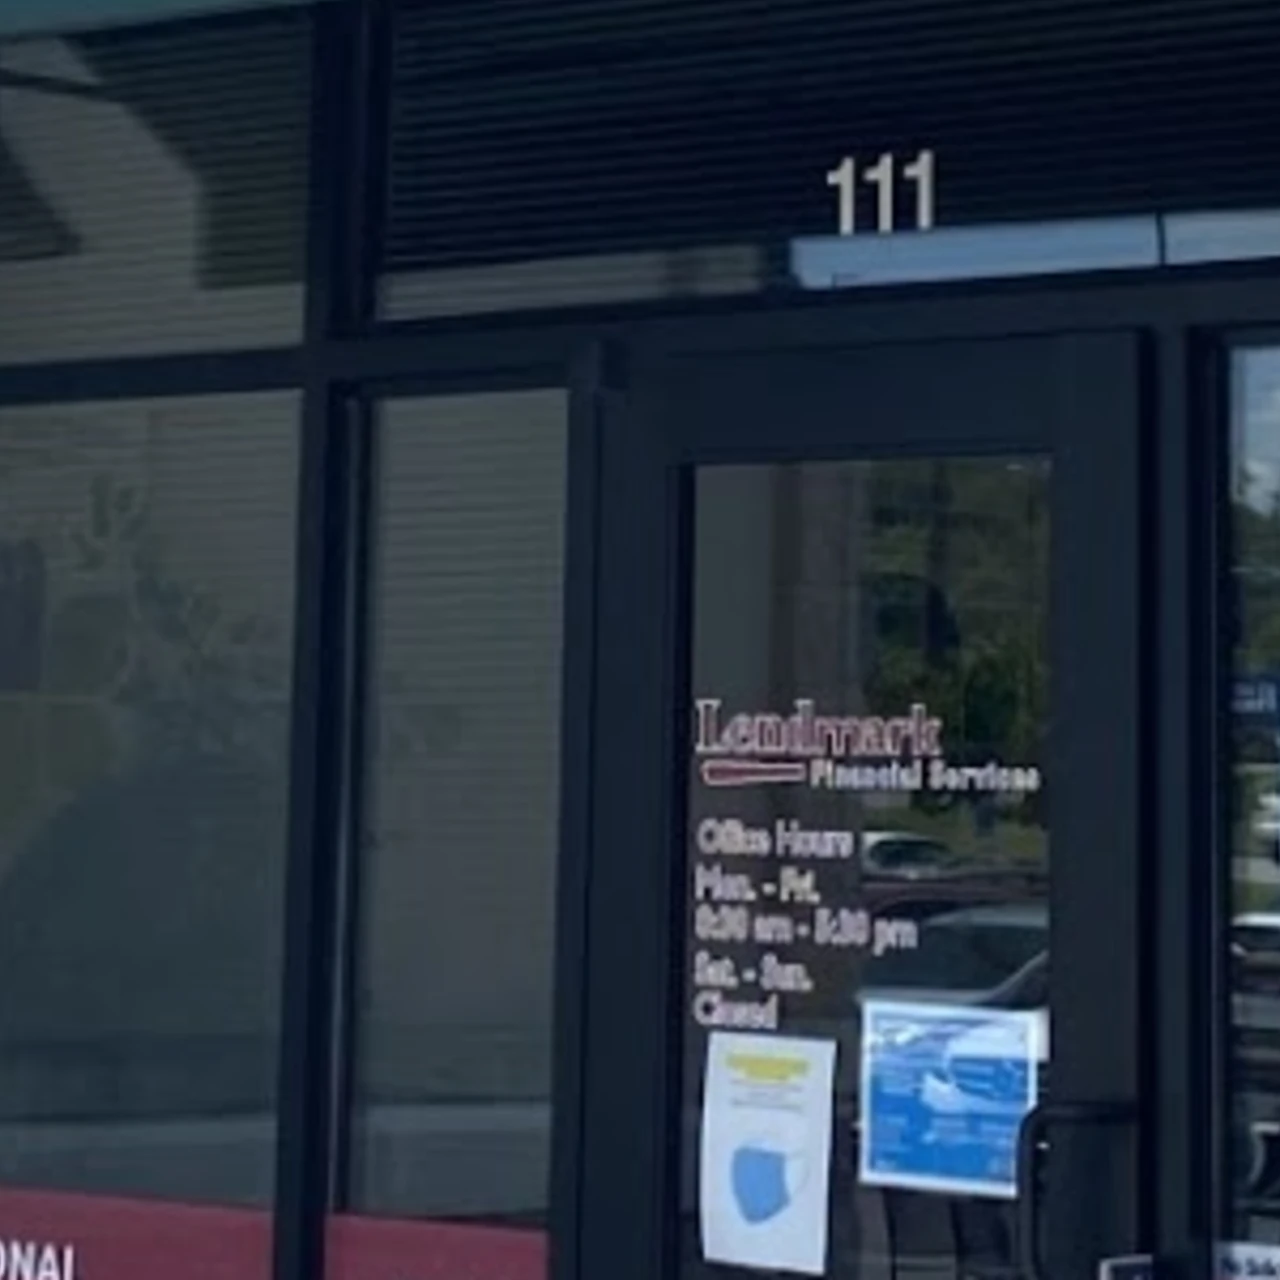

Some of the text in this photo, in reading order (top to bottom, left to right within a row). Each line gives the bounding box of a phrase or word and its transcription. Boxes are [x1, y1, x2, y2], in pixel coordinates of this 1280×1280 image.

[826, 149, 934, 236] 111
[695, 699, 943, 756] Lendmark
[810, 759, 1041, 792] Financial Services
[698, 818, 854, 858] Office Hours
[872, 919, 918, 957] pm
[694, 989, 779, 1030] Closed
